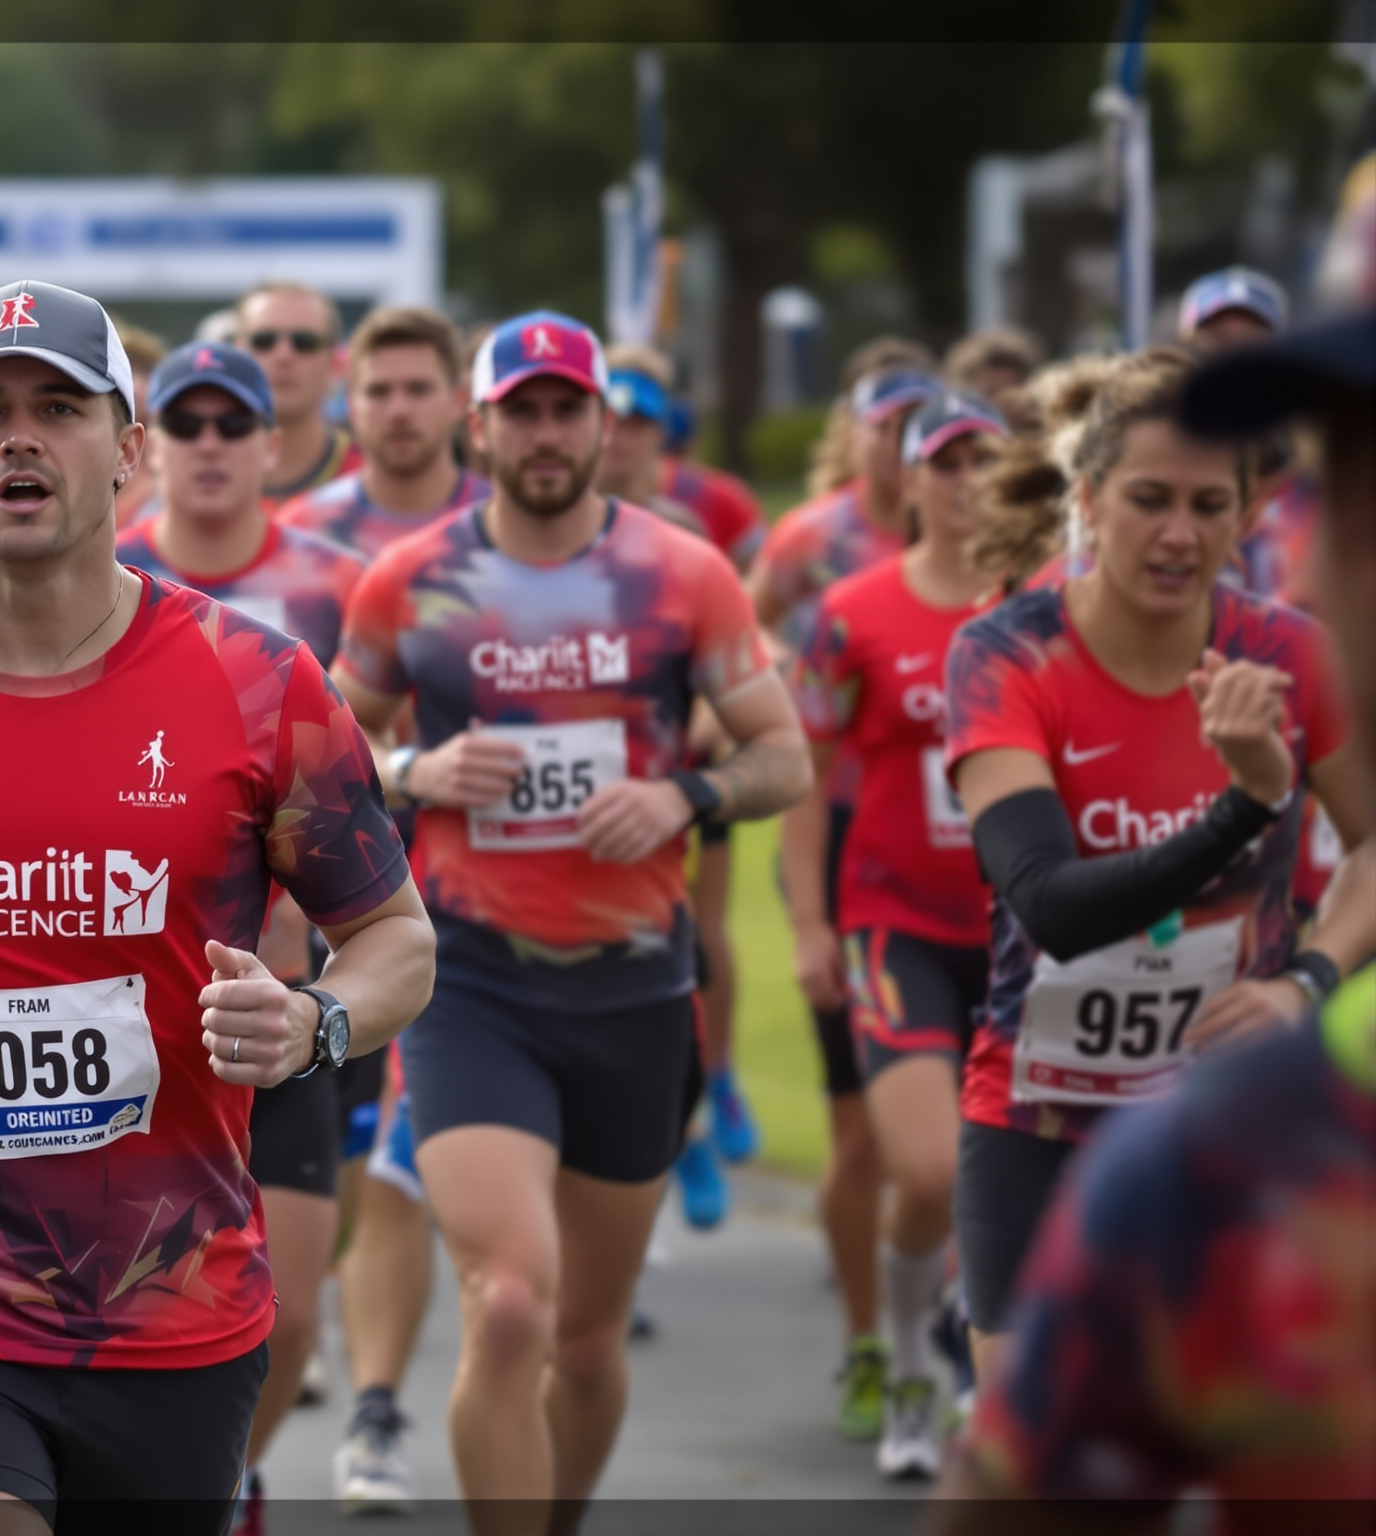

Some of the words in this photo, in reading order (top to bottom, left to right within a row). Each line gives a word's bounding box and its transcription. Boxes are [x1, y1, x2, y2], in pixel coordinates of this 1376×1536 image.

[8, 999, 50, 1014] FRAM
[1074, 984, 1202, 1060] 957
[7, 1107, 93, 1129] OREINITED
